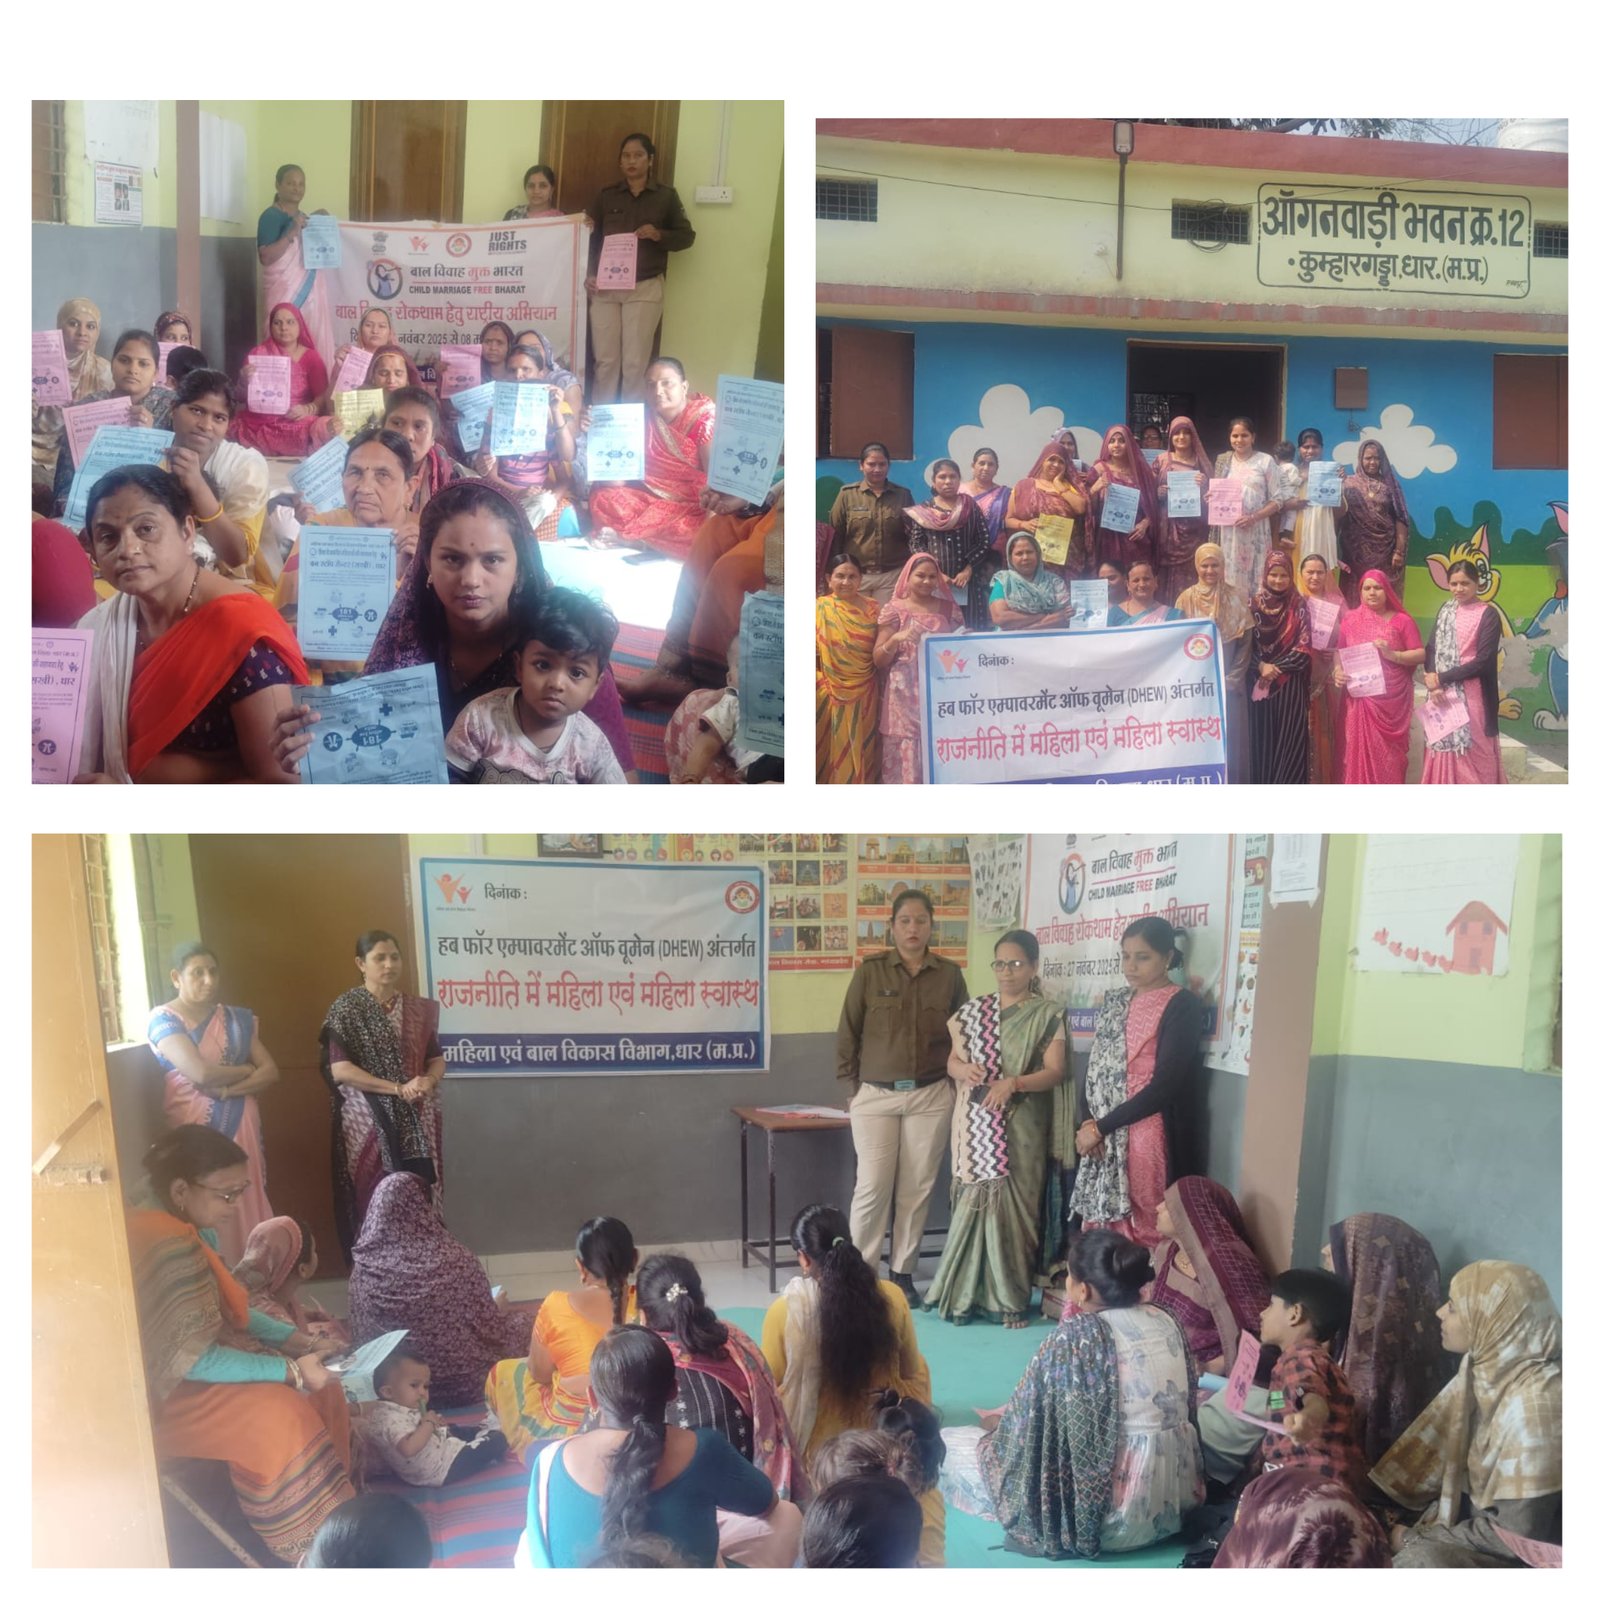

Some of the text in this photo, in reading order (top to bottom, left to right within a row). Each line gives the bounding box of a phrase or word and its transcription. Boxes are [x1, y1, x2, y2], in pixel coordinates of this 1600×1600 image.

[1402, 203, 1469, 245] भवन
[488, 240, 527, 252] RIGHTS
[489, 231, 517, 241] JUST
[410, 263, 524, 281] बाल विवाह मुक्त भारत
[409, 286, 526, 294] CHILD MARRIAGE FREE BHARAT
[336, 304, 357, 320] बाल
[395, 301, 443, 320] रोकथाम
[446, 301, 464, 326] हेतु
[507, 301, 557, 320] अभियान
[398, 329, 425, 344] नवंबर
[427, 333, 447, 344] 2025
[450, 330, 459, 344] से
[461, 333, 472, 344] 08
[978, 653, 1009, 667] दिनांक
[958, 693, 985, 716] फॉर
[1059, 686, 1089, 709] ऑफ
[1092, 684, 1124, 712] वूमेन
[1127, 686, 1168, 707] (DHEW)
[1170, 677, 1214, 699] अंतर्गत
[936, 725, 1007, 764] राजनीति
[1011, 724, 1027, 756] में
[1030, 721, 1080, 758] महिला
[1084, 718, 1109, 759] एवं
[1113, 715, 1162, 750] महिला
[1091, 858, 1108, 874] बाल
[484, 882, 521, 900] दिनांक
[1088, 886, 1104, 901] CHILD
[1136, 879, 1153, 893] FREE
[1155, 873, 1178, 890] BHARAT
[438, 936, 459, 955] हब
[462, 929, 493, 955] फॉर
[580, 932, 615, 956] ऑफ
[618, 933, 655, 964] वूमेन
[658, 938, 704, 962] (DHEW)
[707, 933, 756, 957] अंतर्गत
[437, 969, 760, 1016] राजनीति में महिला एवं महिला स्वास्थ
[442, 1038, 496, 1063] महिला
[500, 1039, 523, 1064] एवं
[526, 1045, 557, 1062] बाल
[561, 1038, 615, 1062] विकास
[706, 1038, 756, 1061] (म.प्र.)
